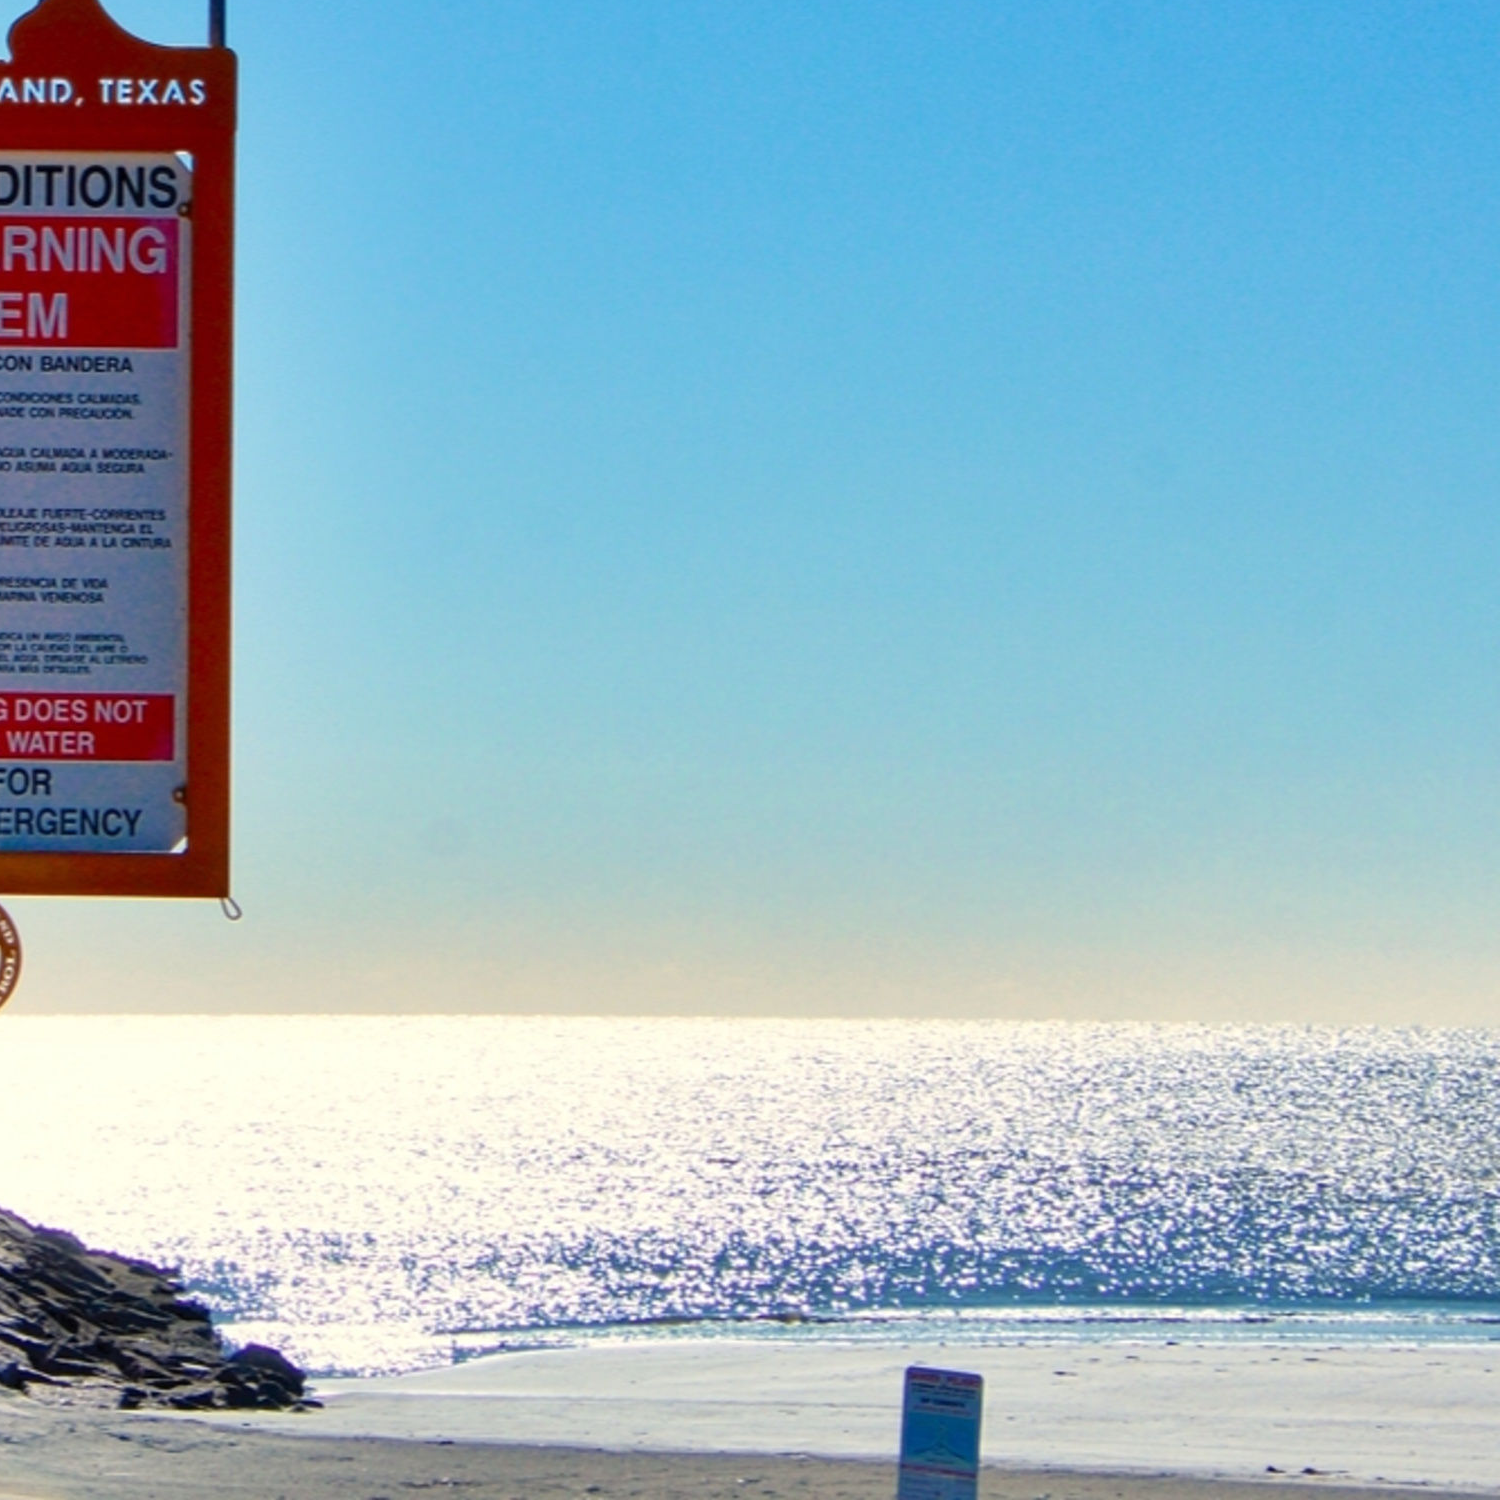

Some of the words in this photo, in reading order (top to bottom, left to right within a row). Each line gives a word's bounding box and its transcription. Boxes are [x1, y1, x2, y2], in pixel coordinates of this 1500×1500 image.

[98, 78, 206, 106] TEXAS
[41, 355, 133, 373] BANDERA
[29, 407, 56, 419] CON
[30, 447, 86, 459] CALMADA
[90, 448, 98, 459] A
[15, 462, 57, 472] ASUMA
[60, 462, 92, 473] AGUA
[96, 462, 145, 474] SEGURA
[139, 524, 155, 535] EL
[34, 536, 50, 547] DE
[54, 536, 86, 548] AGUA
[89, 537, 98, 548] A
[102, 537, 117, 548] LA
[121, 537, 173, 549] CINTURA
[61, 577, 78, 589] DE
[81, 578, 109, 589] VIDA
[40, 591, 104, 603] VENENOSA
[14, 698, 88, 722] DOES
[94, 700, 149, 723] NOT
[5, 730, 95, 754] WATER
